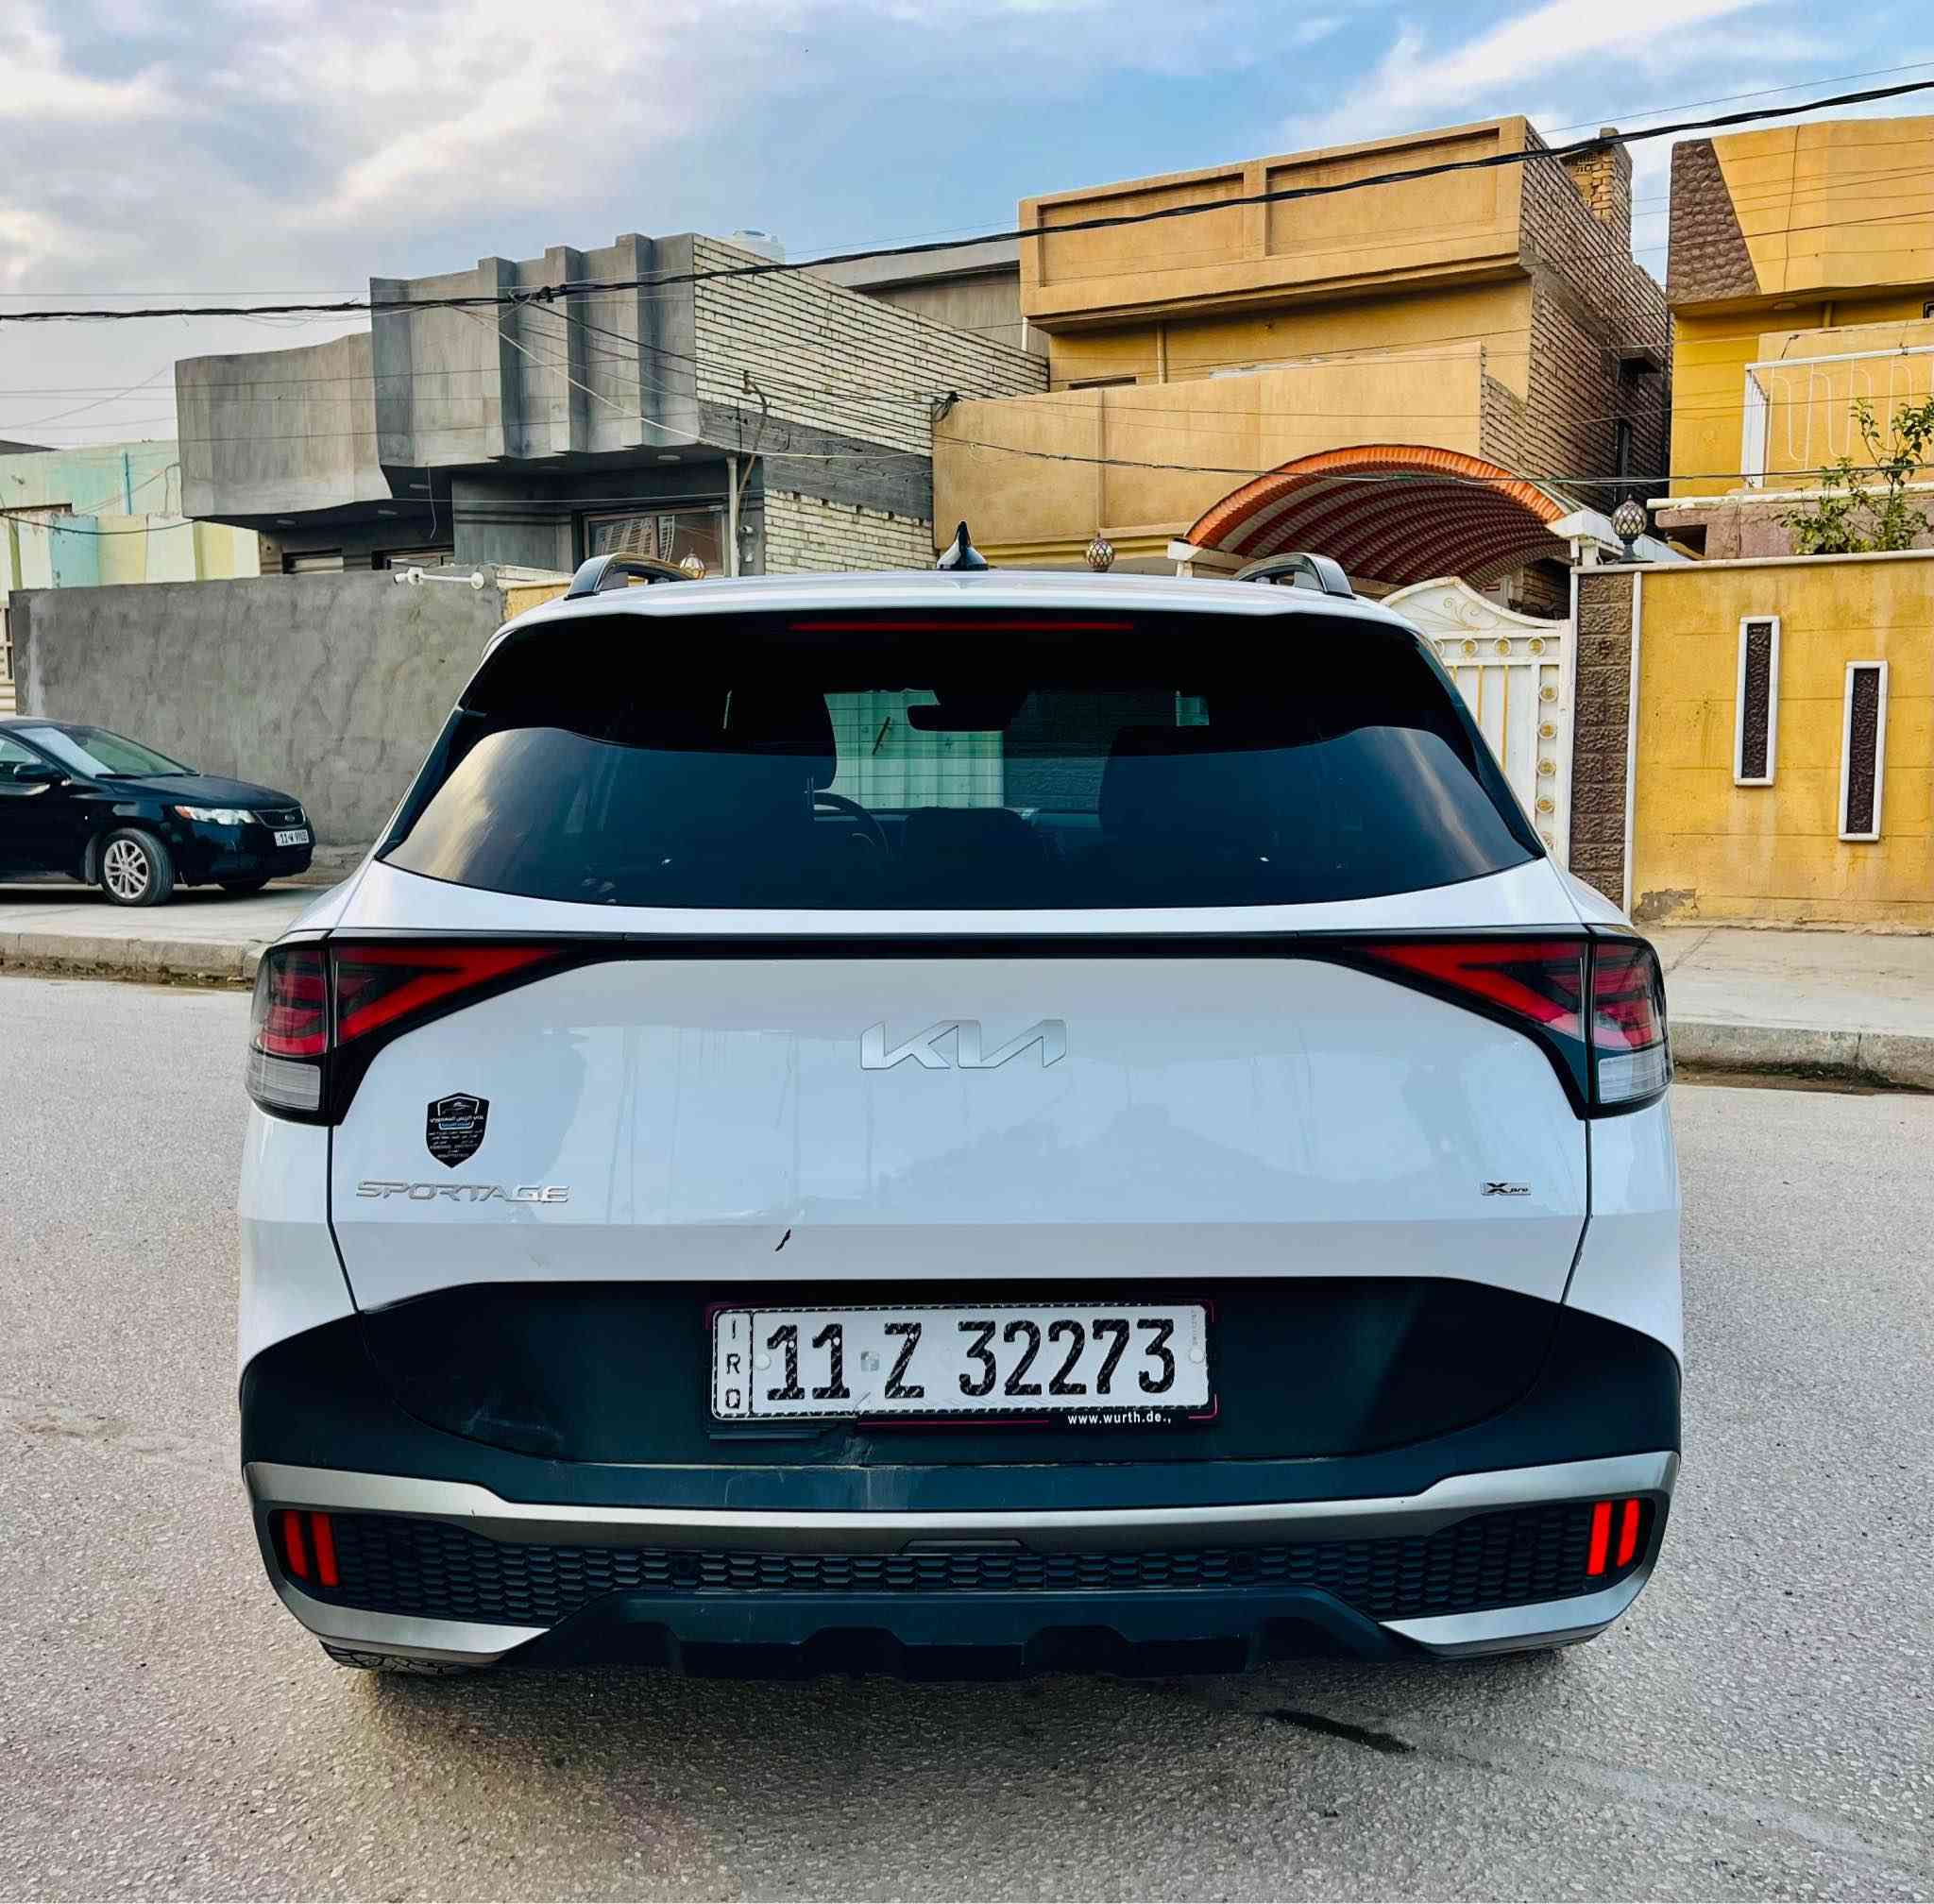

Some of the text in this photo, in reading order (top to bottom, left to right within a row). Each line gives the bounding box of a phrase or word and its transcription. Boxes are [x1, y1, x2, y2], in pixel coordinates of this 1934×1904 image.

[860, 1019, 1066, 1070] KIA
[356, 1181, 569, 1202] SPORTAGE
[767, 1323, 851, 1401] 11
[884, 1321, 925, 1399] Z
[958, 1318, 1176, 1397] 32273
